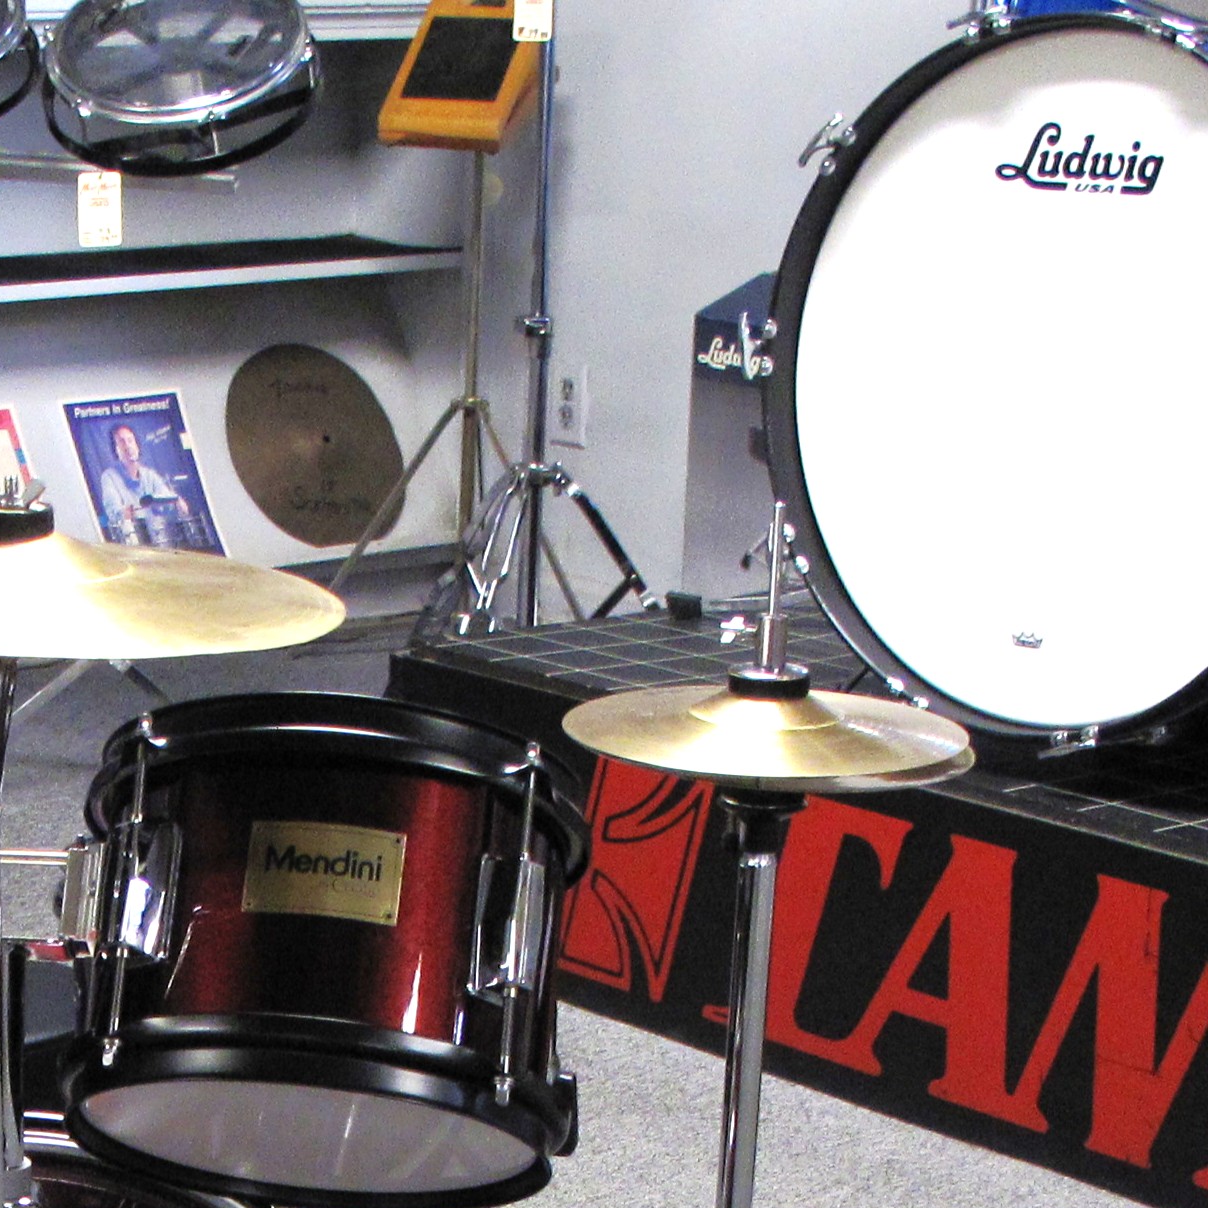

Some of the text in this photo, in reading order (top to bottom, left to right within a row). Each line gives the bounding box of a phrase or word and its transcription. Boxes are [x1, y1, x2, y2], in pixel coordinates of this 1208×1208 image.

[995, 122, 1164, 195] Ludwig
[1075, 183, 1115, 194] USA
[697, 337, 762, 377] Ludwg
[74, 406, 111, 418] Partners
[123, 400, 170, 414] Greatness!
[265, 845, 382, 882] Mendini
